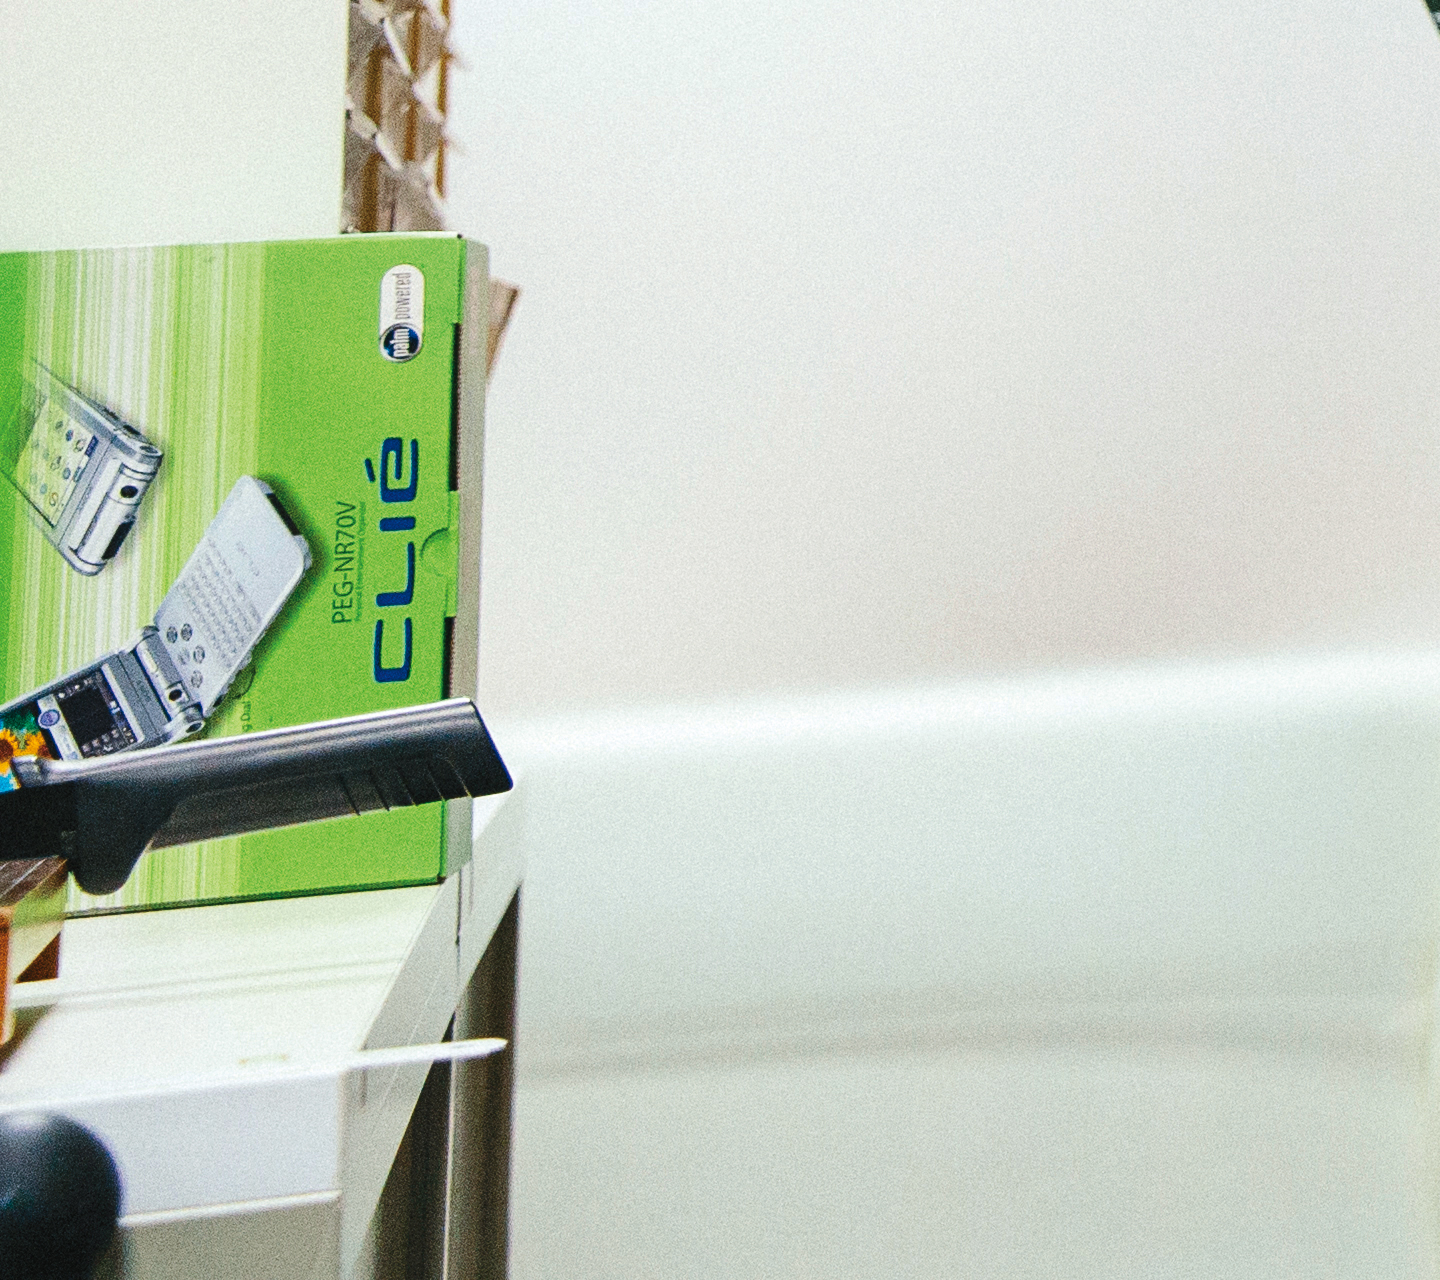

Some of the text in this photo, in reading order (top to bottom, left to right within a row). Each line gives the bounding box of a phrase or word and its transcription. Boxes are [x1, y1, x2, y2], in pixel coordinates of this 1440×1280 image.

[389, 272, 415, 359] palm powered
[331, 500, 358, 624] PEG-NR70V
